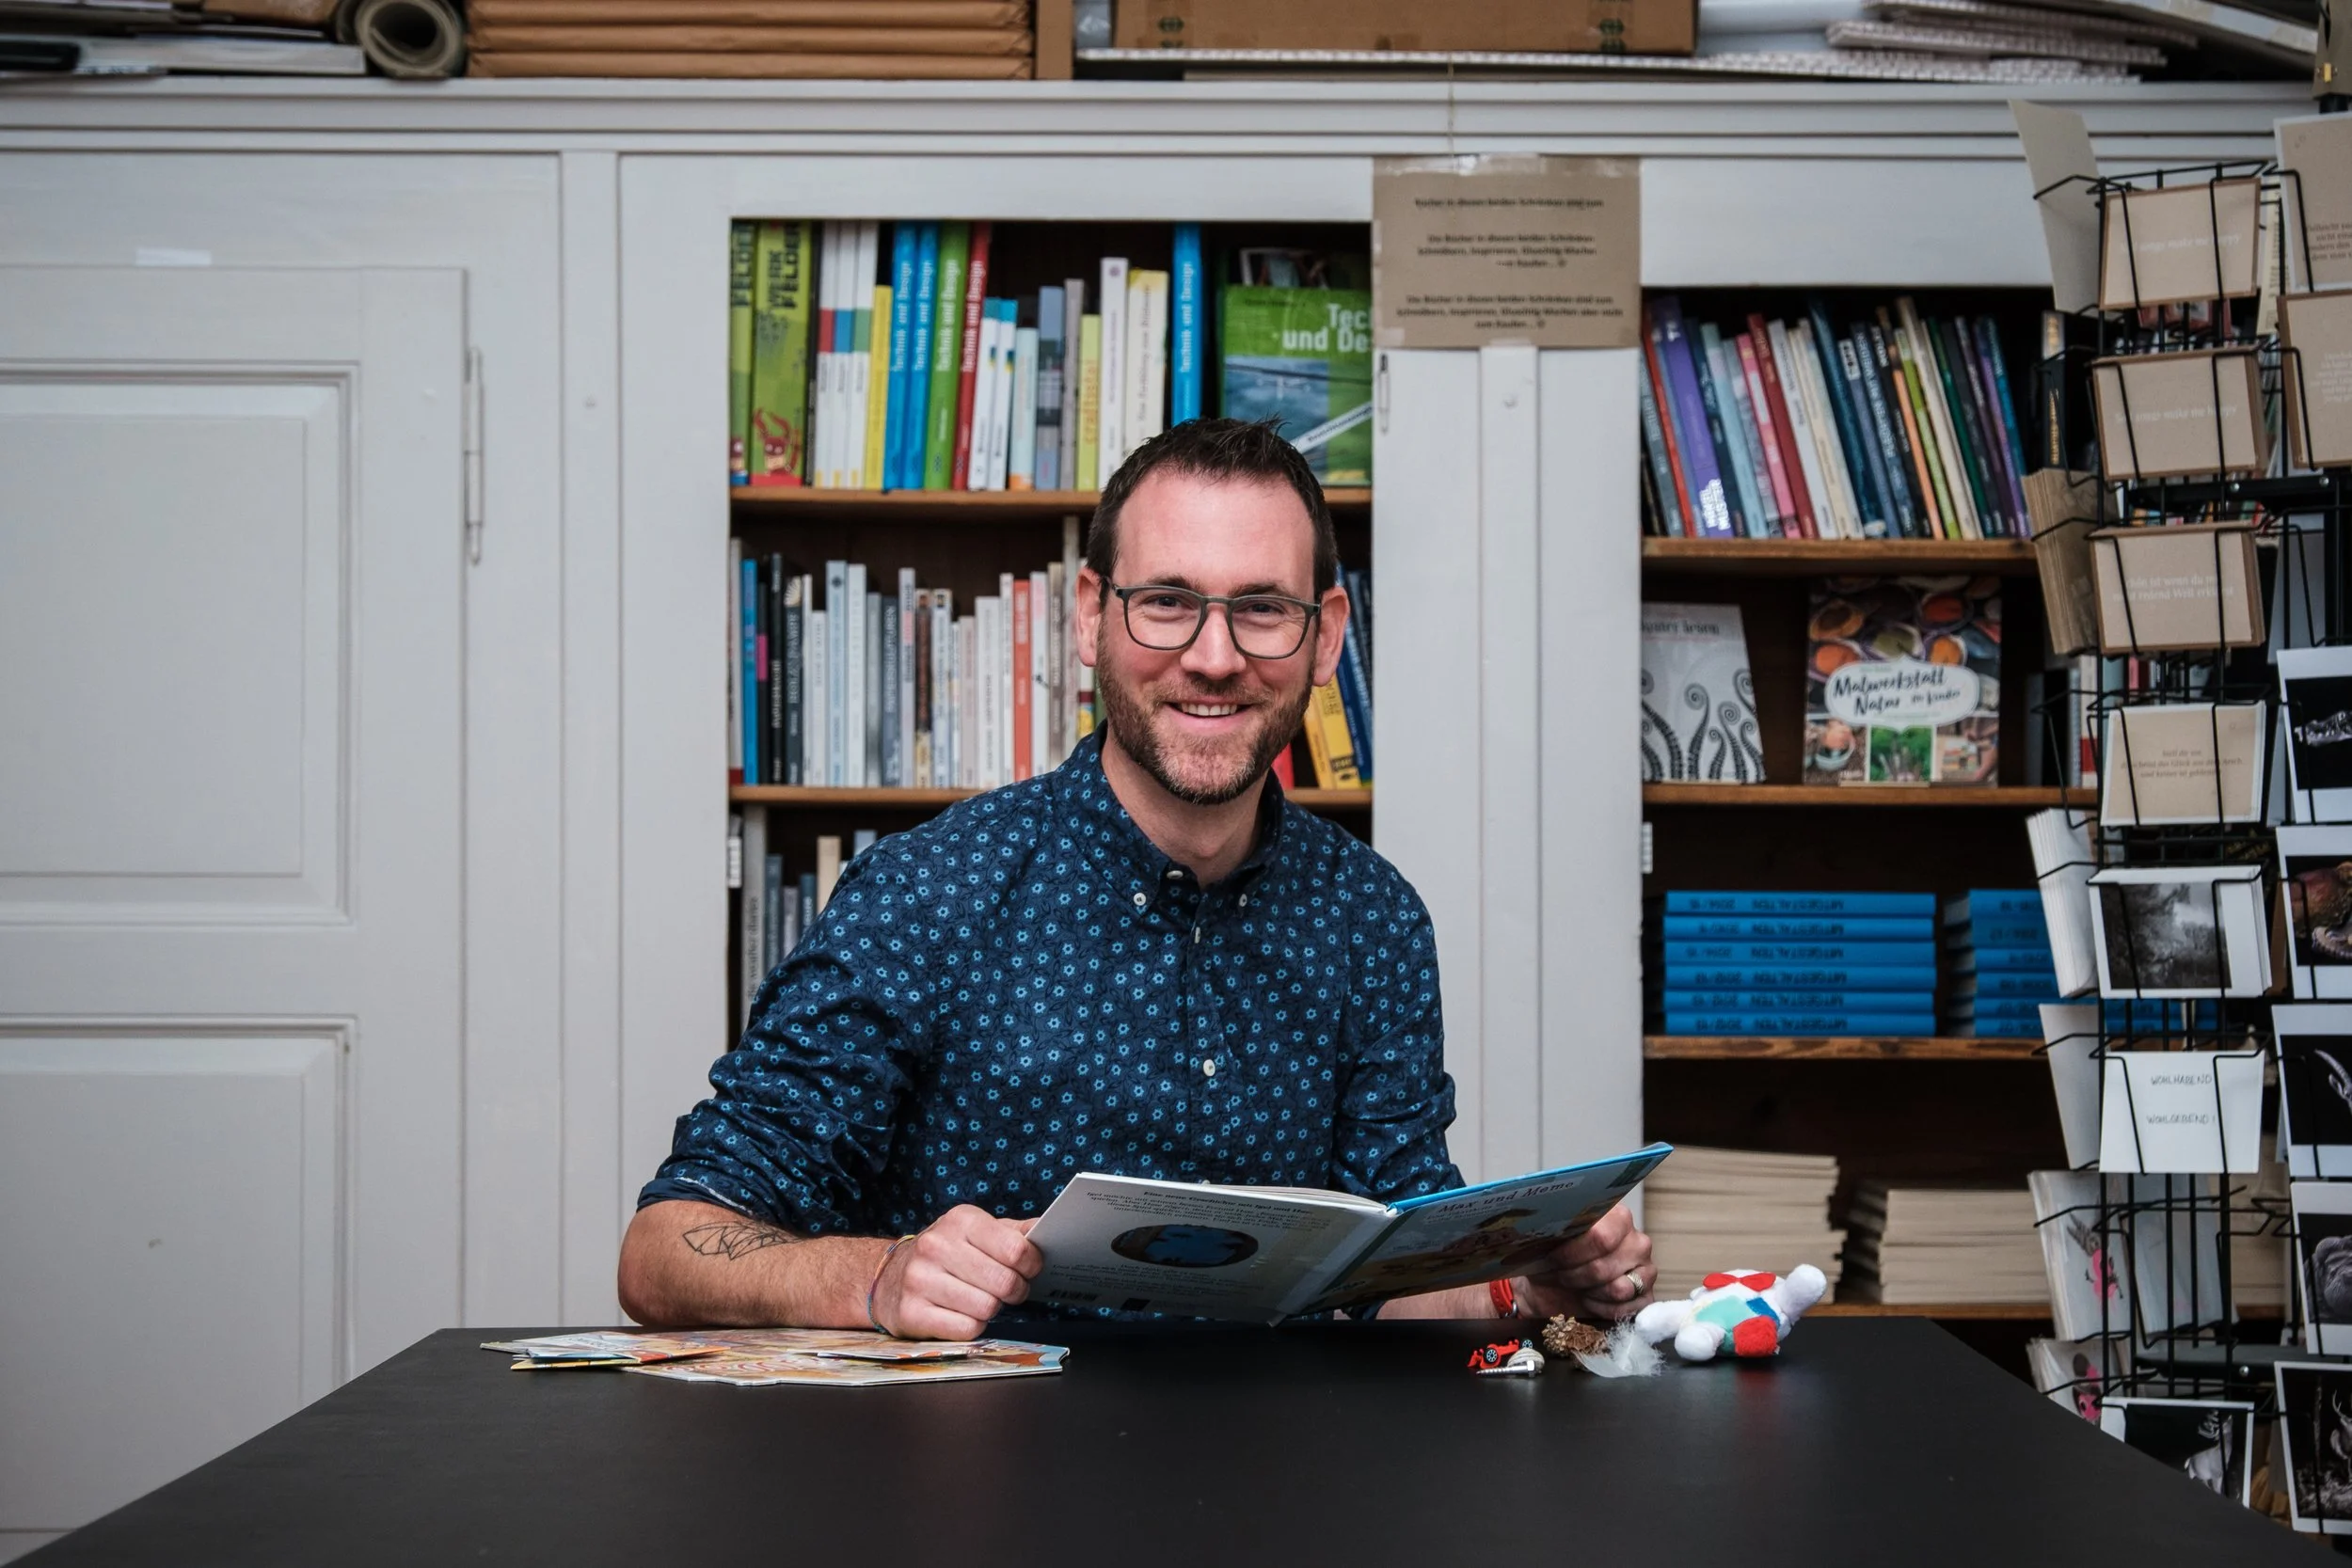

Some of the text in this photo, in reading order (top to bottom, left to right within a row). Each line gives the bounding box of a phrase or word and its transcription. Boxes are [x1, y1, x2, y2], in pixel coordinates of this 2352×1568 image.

[897, 261, 912, 300] Design
[917, 261, 933, 299] Design
[941, 260, 961, 299] Design
[966, 261, 986, 299] Design
[1182, 262, 1196, 300] Design
[896, 303, 908, 324] und
[916, 303, 930, 323] und
[938, 303, 954, 325] und
[964, 303, 978, 326] und
[1181, 304, 1193, 324] und
[1282, 326, 1328, 351] und
[1833, 666, 1945, 697] Malwerkstatt
[1854, 695, 1900, 716] Natur
[1484, 1190, 1518, 1206] und
